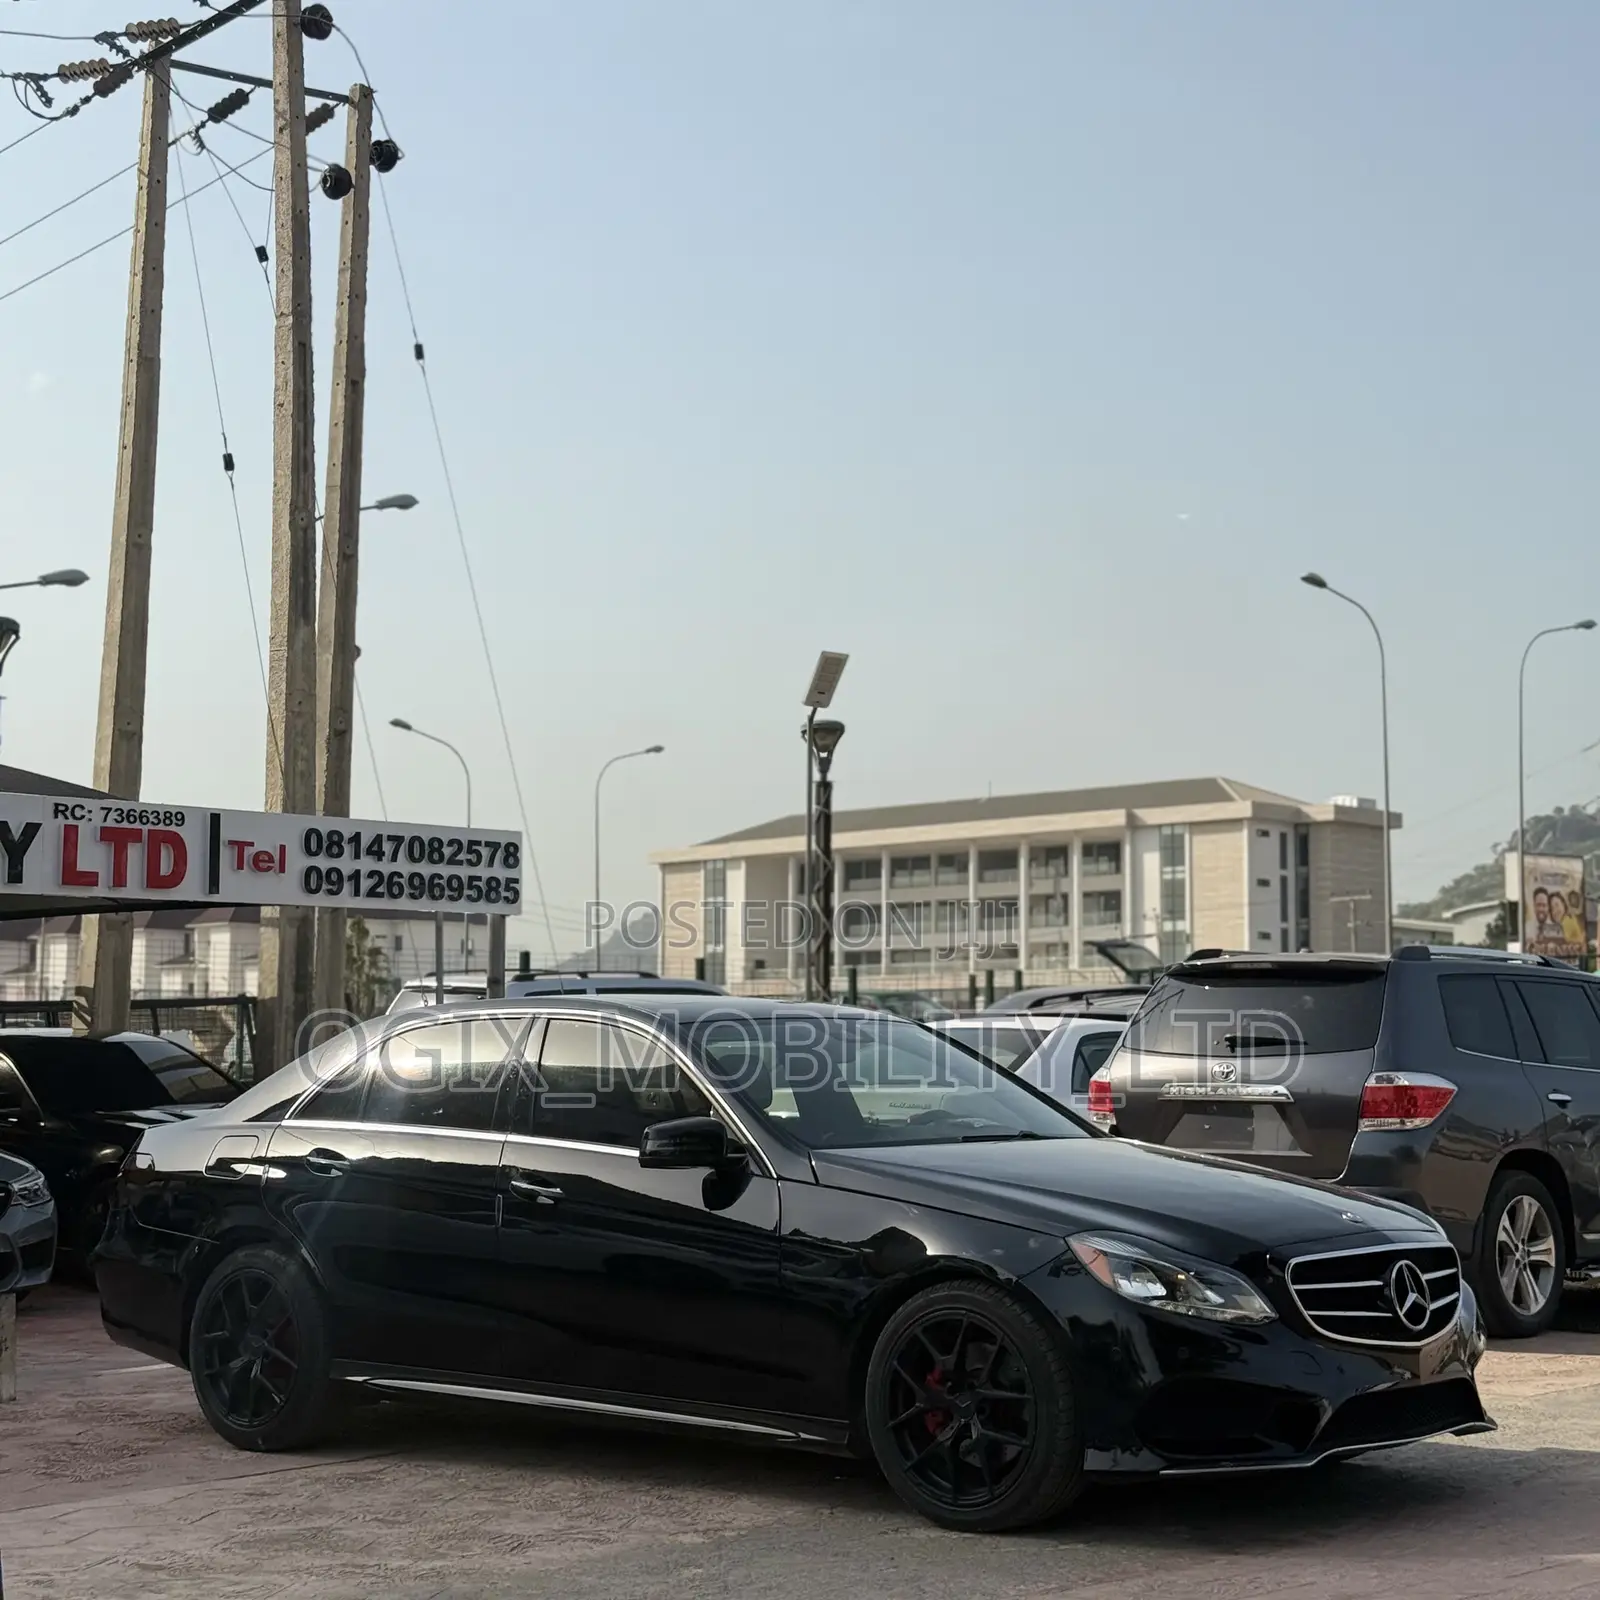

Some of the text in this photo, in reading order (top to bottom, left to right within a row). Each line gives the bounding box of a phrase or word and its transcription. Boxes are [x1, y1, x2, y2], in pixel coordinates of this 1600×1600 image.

[53, 802, 185, 827] RC: 7366389
[61, 823, 188, 889] LTD
[228, 839, 287, 874] Tel
[303, 827, 520, 869] 08147082578
[303, 865, 520, 905] 09126969585
